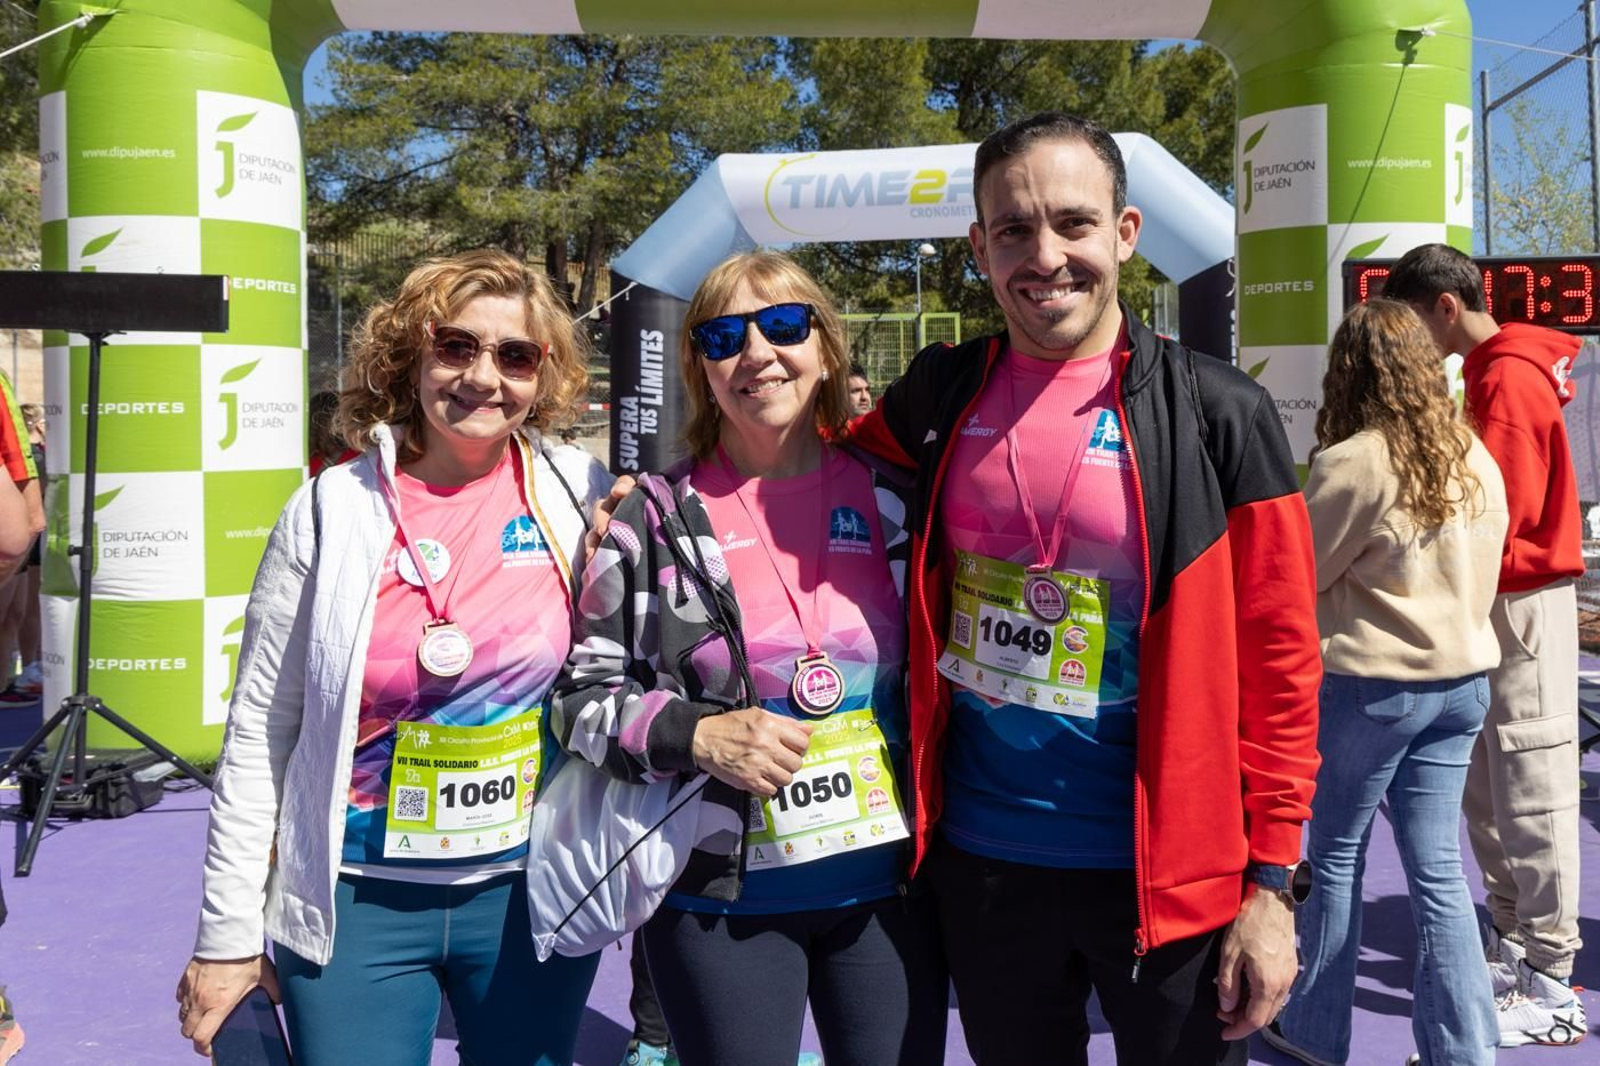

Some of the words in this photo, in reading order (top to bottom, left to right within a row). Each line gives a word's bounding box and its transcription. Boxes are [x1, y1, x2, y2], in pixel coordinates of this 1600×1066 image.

[82, 146, 177, 160] www.dipujaen.es
[1254, 159, 1316, 178] DIPUTACIÓN
[1347, 156, 1433, 170] www.dipujaen.es
[239, 168, 256, 181] DE
[258, 171, 283, 186] JAÉN
[1254, 181, 1266, 193] DE
[1266, 178, 1292, 190] JAÉN
[230, 276, 297, 295] EPORTES
[1244, 280, 1314, 296] DEPORTES
[634, 328, 664, 406] LÍMITES
[1274, 398, 1317, 411] TACIÓN
[242, 417, 257, 429] DE
[640, 408, 658, 435] TUS
[620, 396, 639, 471] SUPERA
[102, 530, 189, 543] DIPUTACIÓN
[103, 547, 120, 559] DE
[123, 546, 159, 559] JAÉN
[977, 590, 1014, 607] SOLIDARIO
[980, 616, 1053, 657] 1049
[397, 756, 408, 765] VII
[409, 757, 431, 767] TRAIL
[432, 760, 479, 768] SOLIDARIO
[440, 775, 516, 808] 1060
[770, 772, 852, 812] 1050
